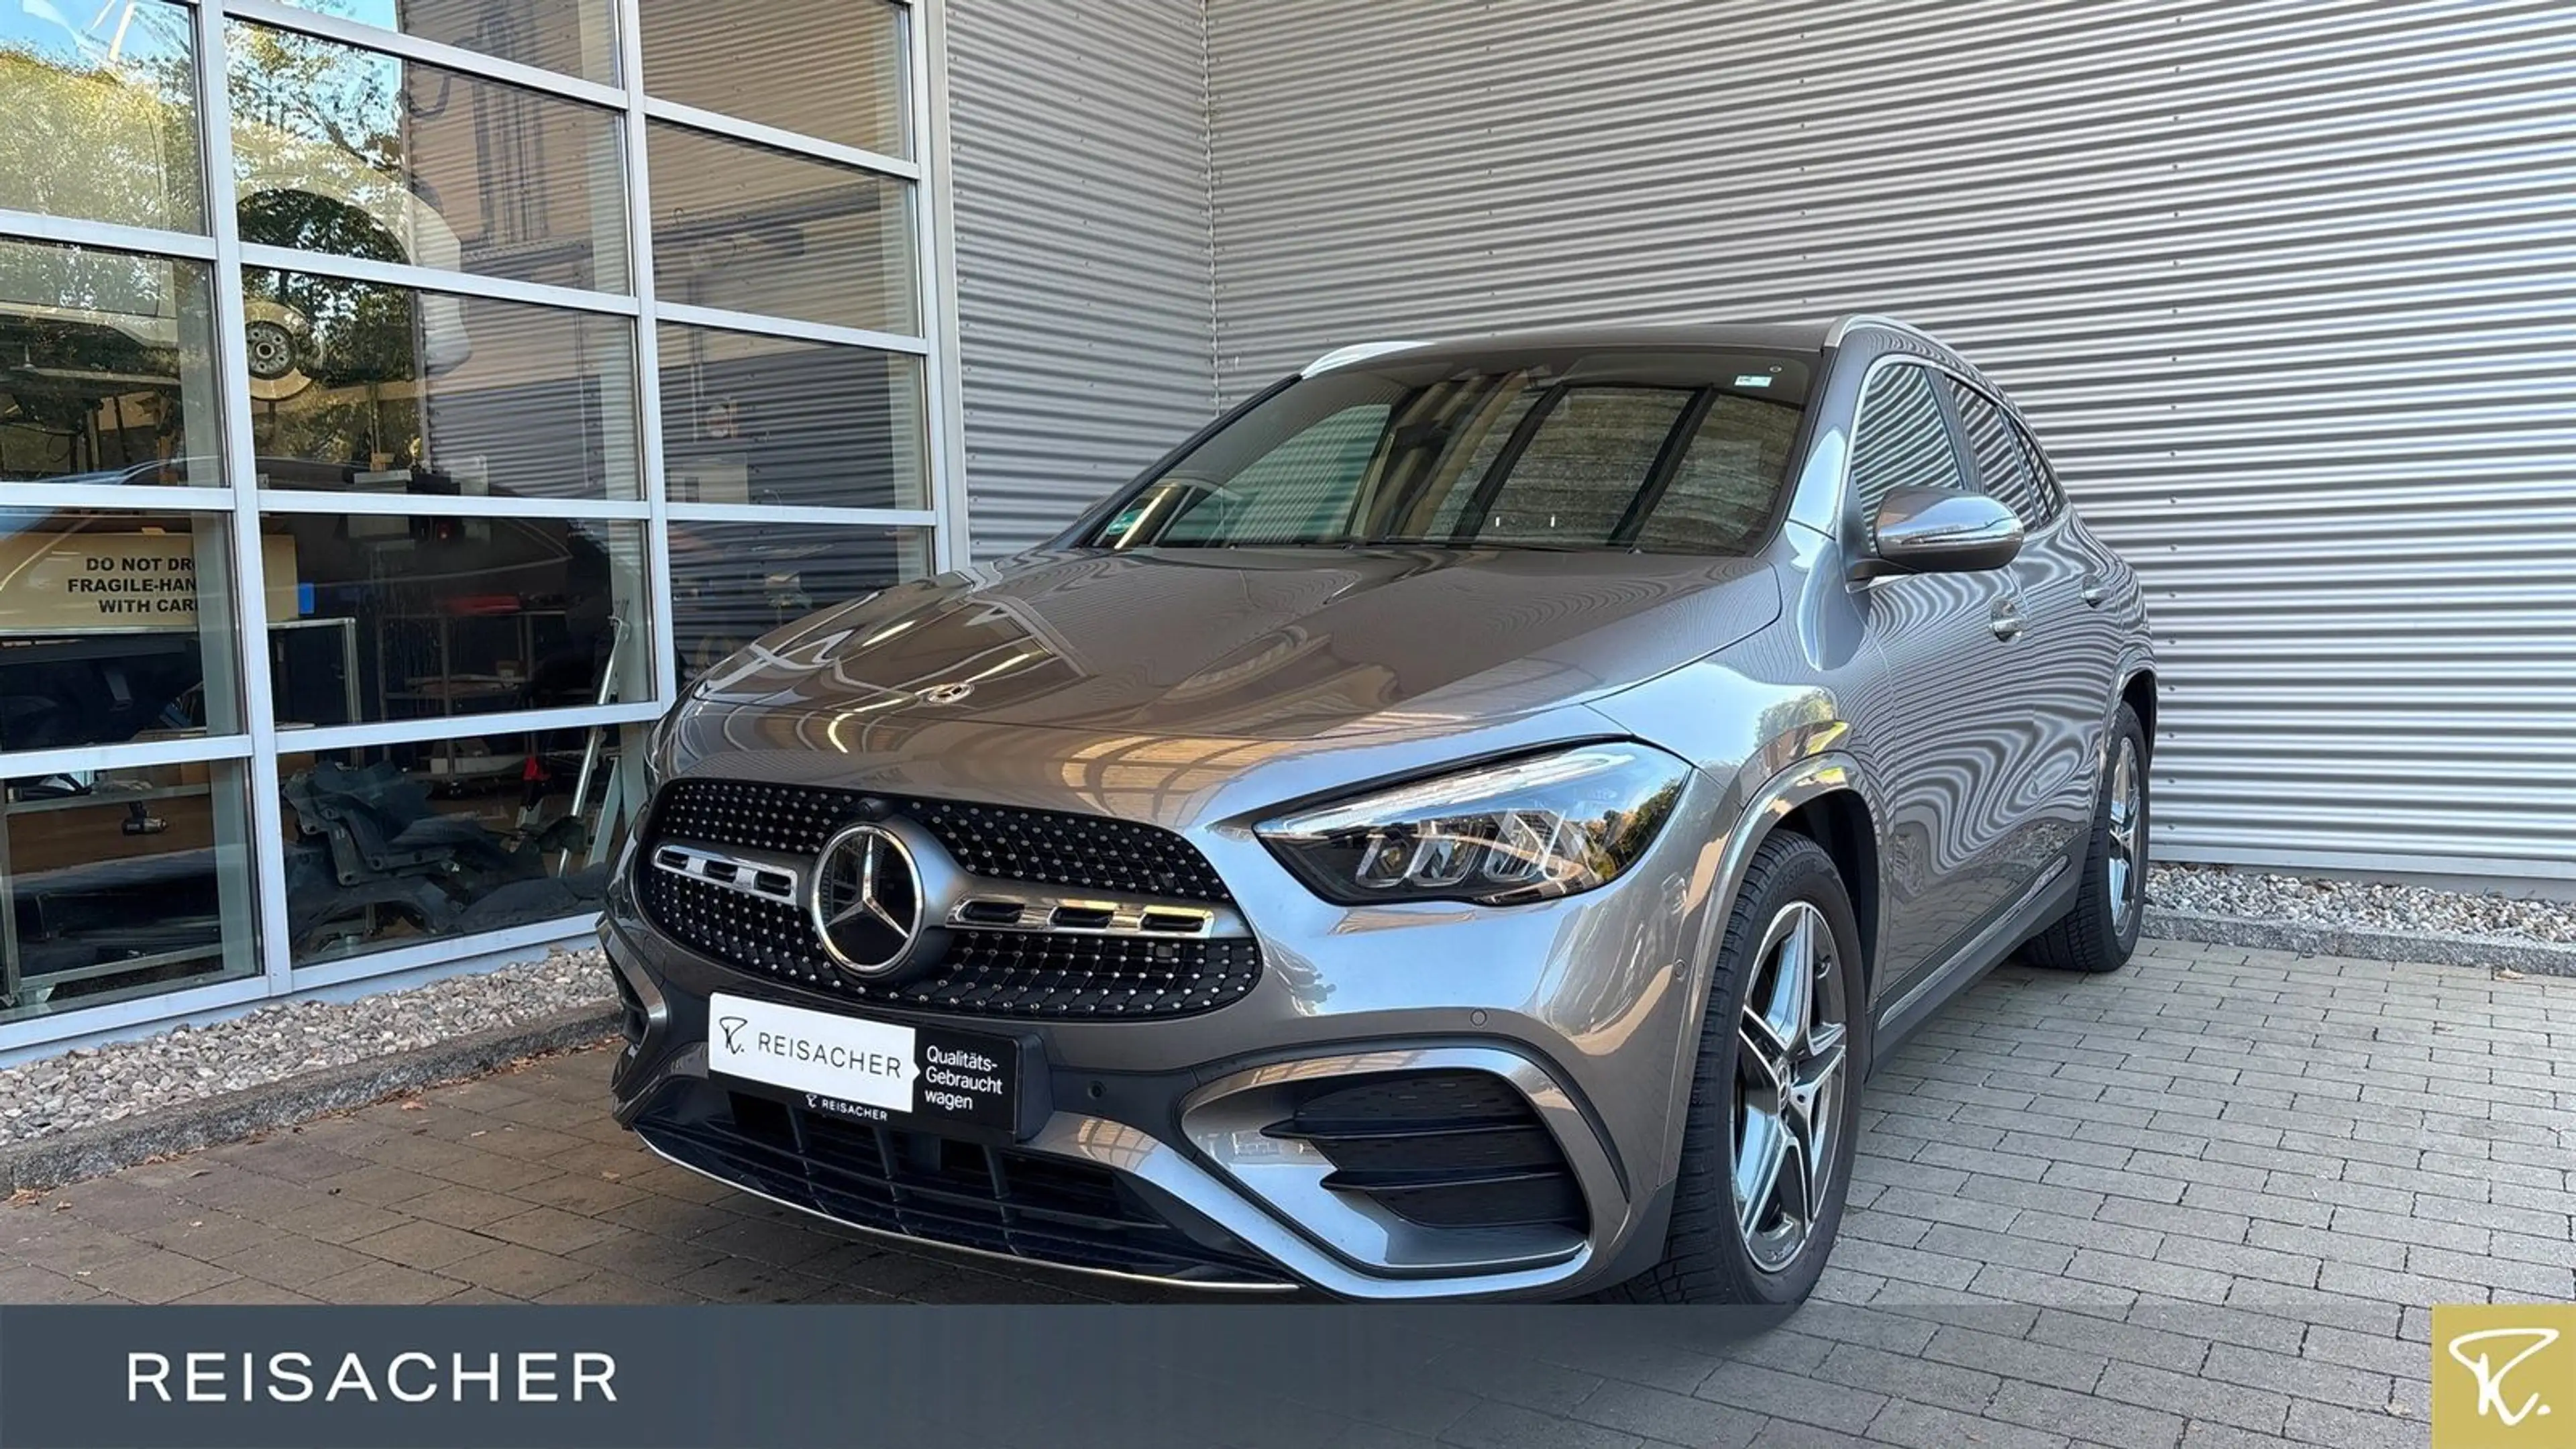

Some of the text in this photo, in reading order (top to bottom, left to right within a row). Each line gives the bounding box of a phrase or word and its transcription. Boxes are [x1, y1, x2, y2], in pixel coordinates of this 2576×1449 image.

[86, 557, 196, 571] DO NOT DR
[99, 599, 151, 613] WITH
[757, 1032, 902, 1079] REISACHER
[926, 1044, 998, 1073] Qualitäts-
[924, 1066, 1004, 1095] Gebraucht
[821, 1099, 889, 1122] REISACHER
[924, 1089, 973, 1112] wagen
